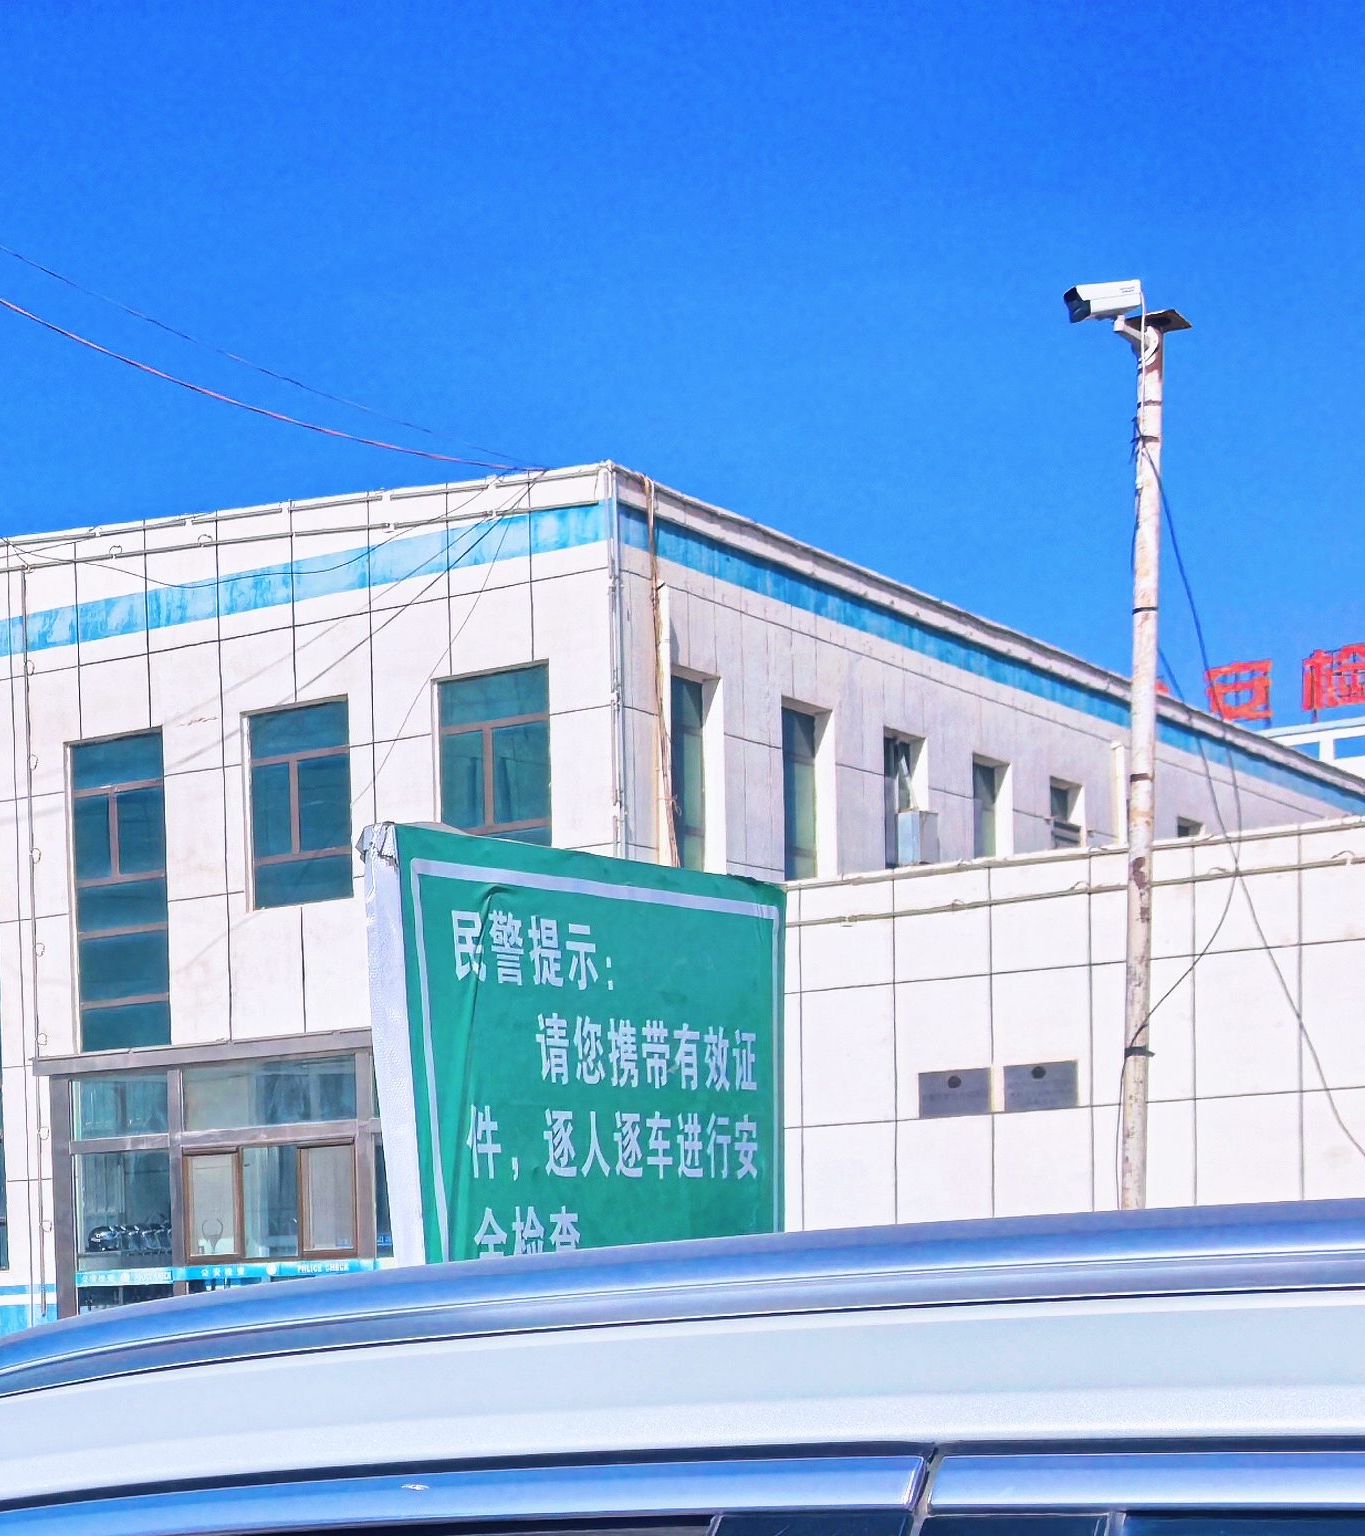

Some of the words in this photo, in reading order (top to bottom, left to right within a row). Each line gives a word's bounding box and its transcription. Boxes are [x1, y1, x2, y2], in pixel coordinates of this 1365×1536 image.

[535, 1012, 758, 1092] 请您携带有效证
